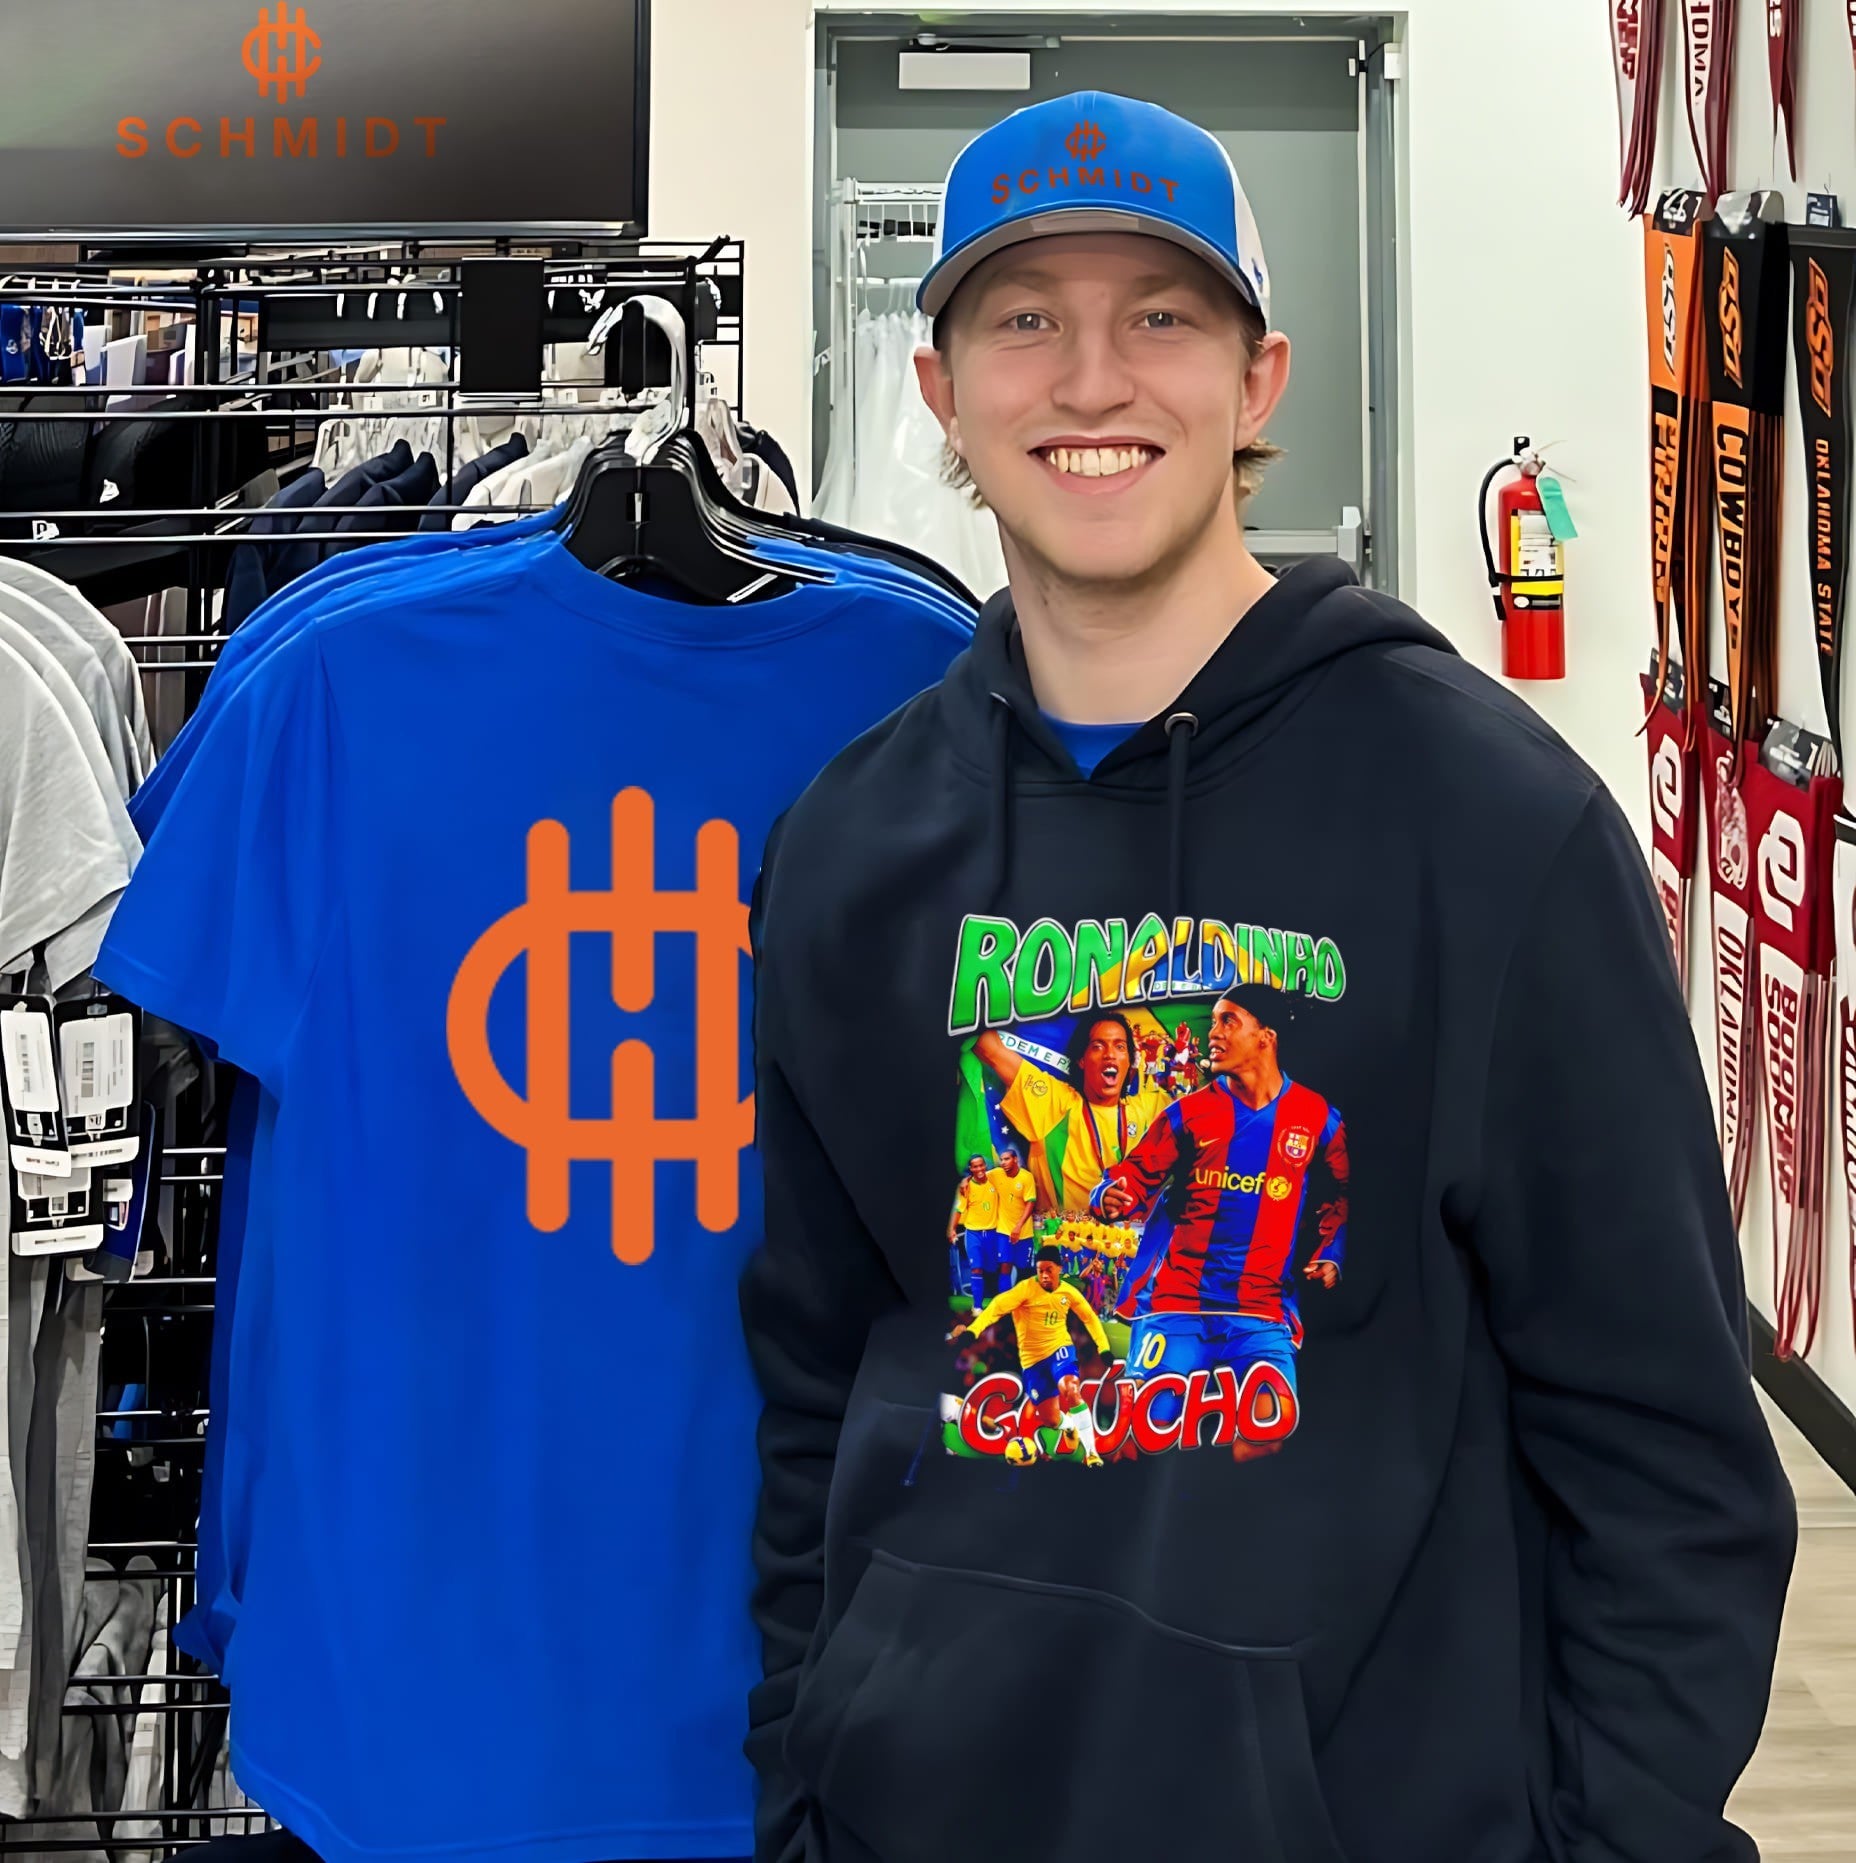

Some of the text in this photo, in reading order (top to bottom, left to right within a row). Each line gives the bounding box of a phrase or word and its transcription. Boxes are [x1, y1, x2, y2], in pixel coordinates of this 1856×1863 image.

[115, 116, 448, 158] SCHMIDT
[991, 167, 1180, 205] SCHMIDT
[948, 912, 1347, 1037] RONALDINHO
[1717, 926, 1745, 1144] OKLAHOMA
[1195, 1165, 1266, 1195] unicef
[1044, 1311, 1058, 1325] 10
[1055, 1346, 1069, 1361] 10
[1134, 1332, 1167, 1370] 10
